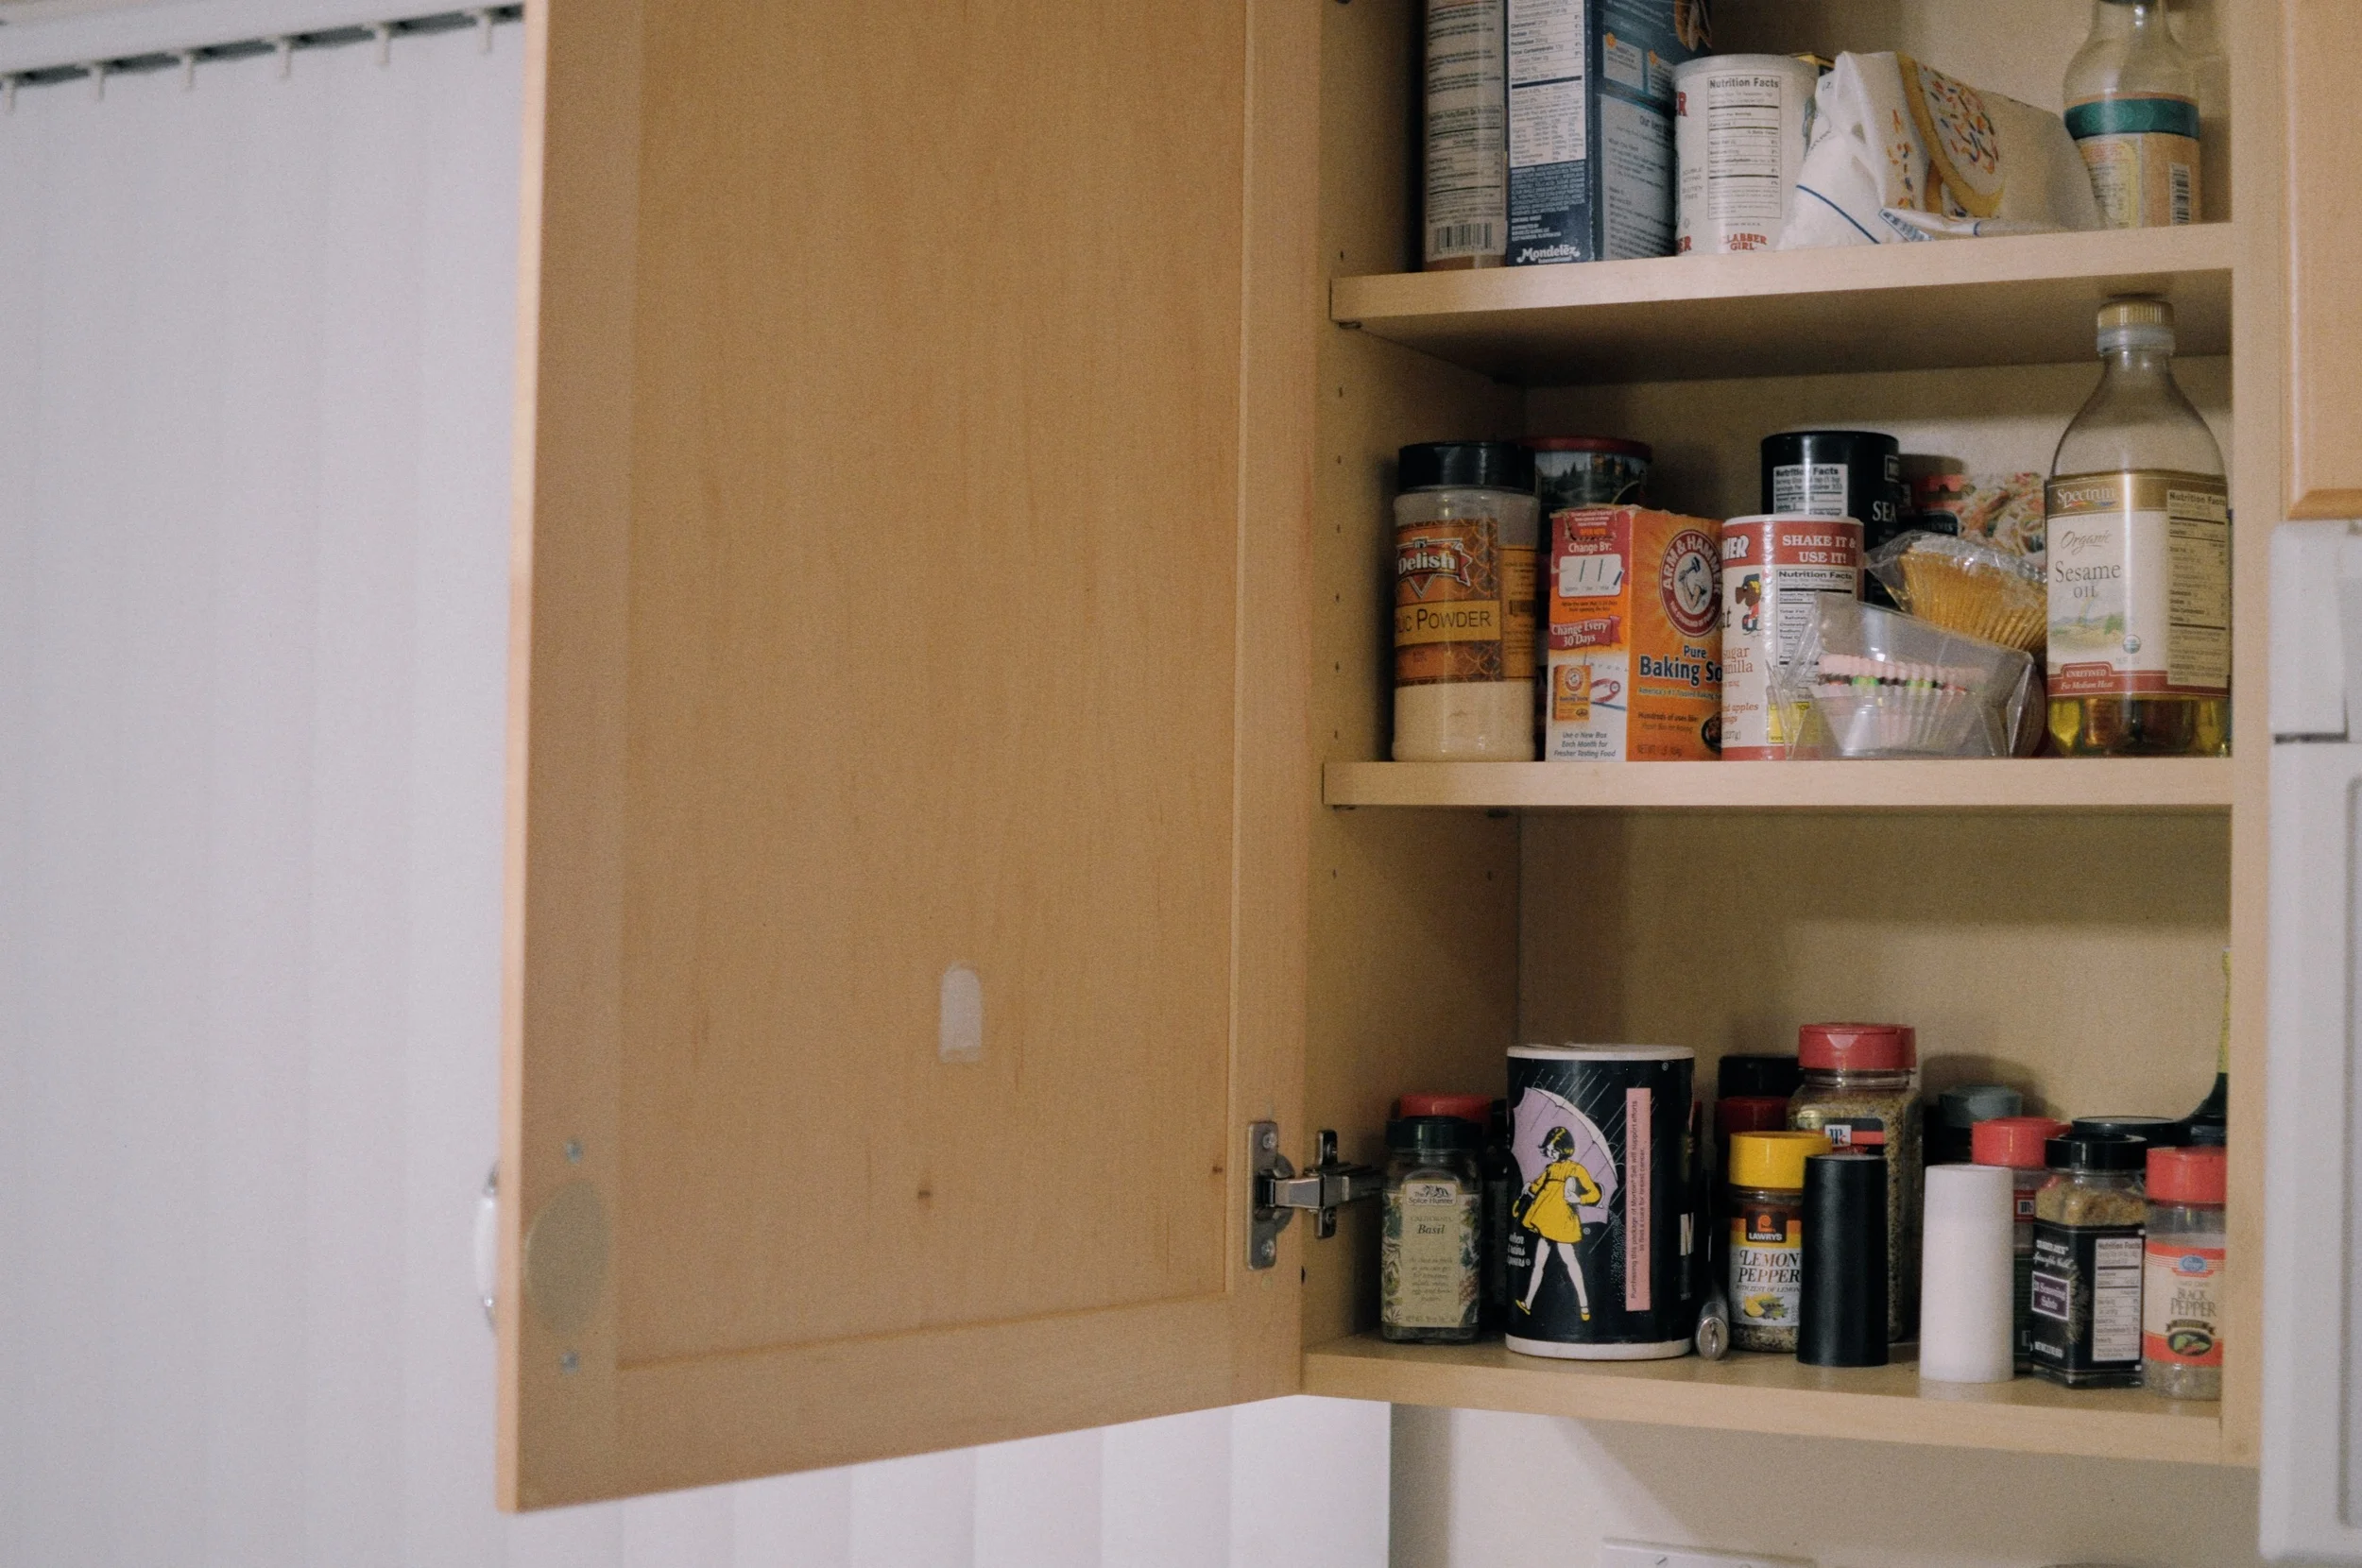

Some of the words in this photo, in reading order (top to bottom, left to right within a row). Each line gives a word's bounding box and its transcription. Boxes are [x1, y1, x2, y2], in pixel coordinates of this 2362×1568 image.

[1709, 77, 1751, 89] Nutrition
[1754, 77, 1779, 89] Facts
[1723, 232, 1768, 246] LABBER
[1730, 242, 1755, 251] GIRL
[2057, 486, 2115, 508] Spectrum
[1872, 501, 1897, 522] SEA
[1568, 542, 1599, 554] Change
[1782, 535, 1832, 547] SHAKE
[1835, 537, 1847, 548] IT
[2061, 530, 2111, 555] Organic
[1398, 551, 1456, 575] Delish
[1798, 552, 1827, 563] USE
[1831, 553, 1847, 564] IT!
[2055, 560, 2121, 583] Sesame
[1550, 624, 1583, 636] Change
[1583, 622, 1608, 634] Every
[1575, 634, 1596, 645] Days
[1684, 644, 1707, 659] Pure
[1639, 655, 1701, 687] Baking
[1732, 702, 1759, 714] apples
[1417, 1223, 1446, 1235] Basil
[1739, 1249, 1800, 1268] LEMON
[1737, 1267, 1800, 1284] PEPPER
[2170, 1297, 2217, 1318] PEPPER
